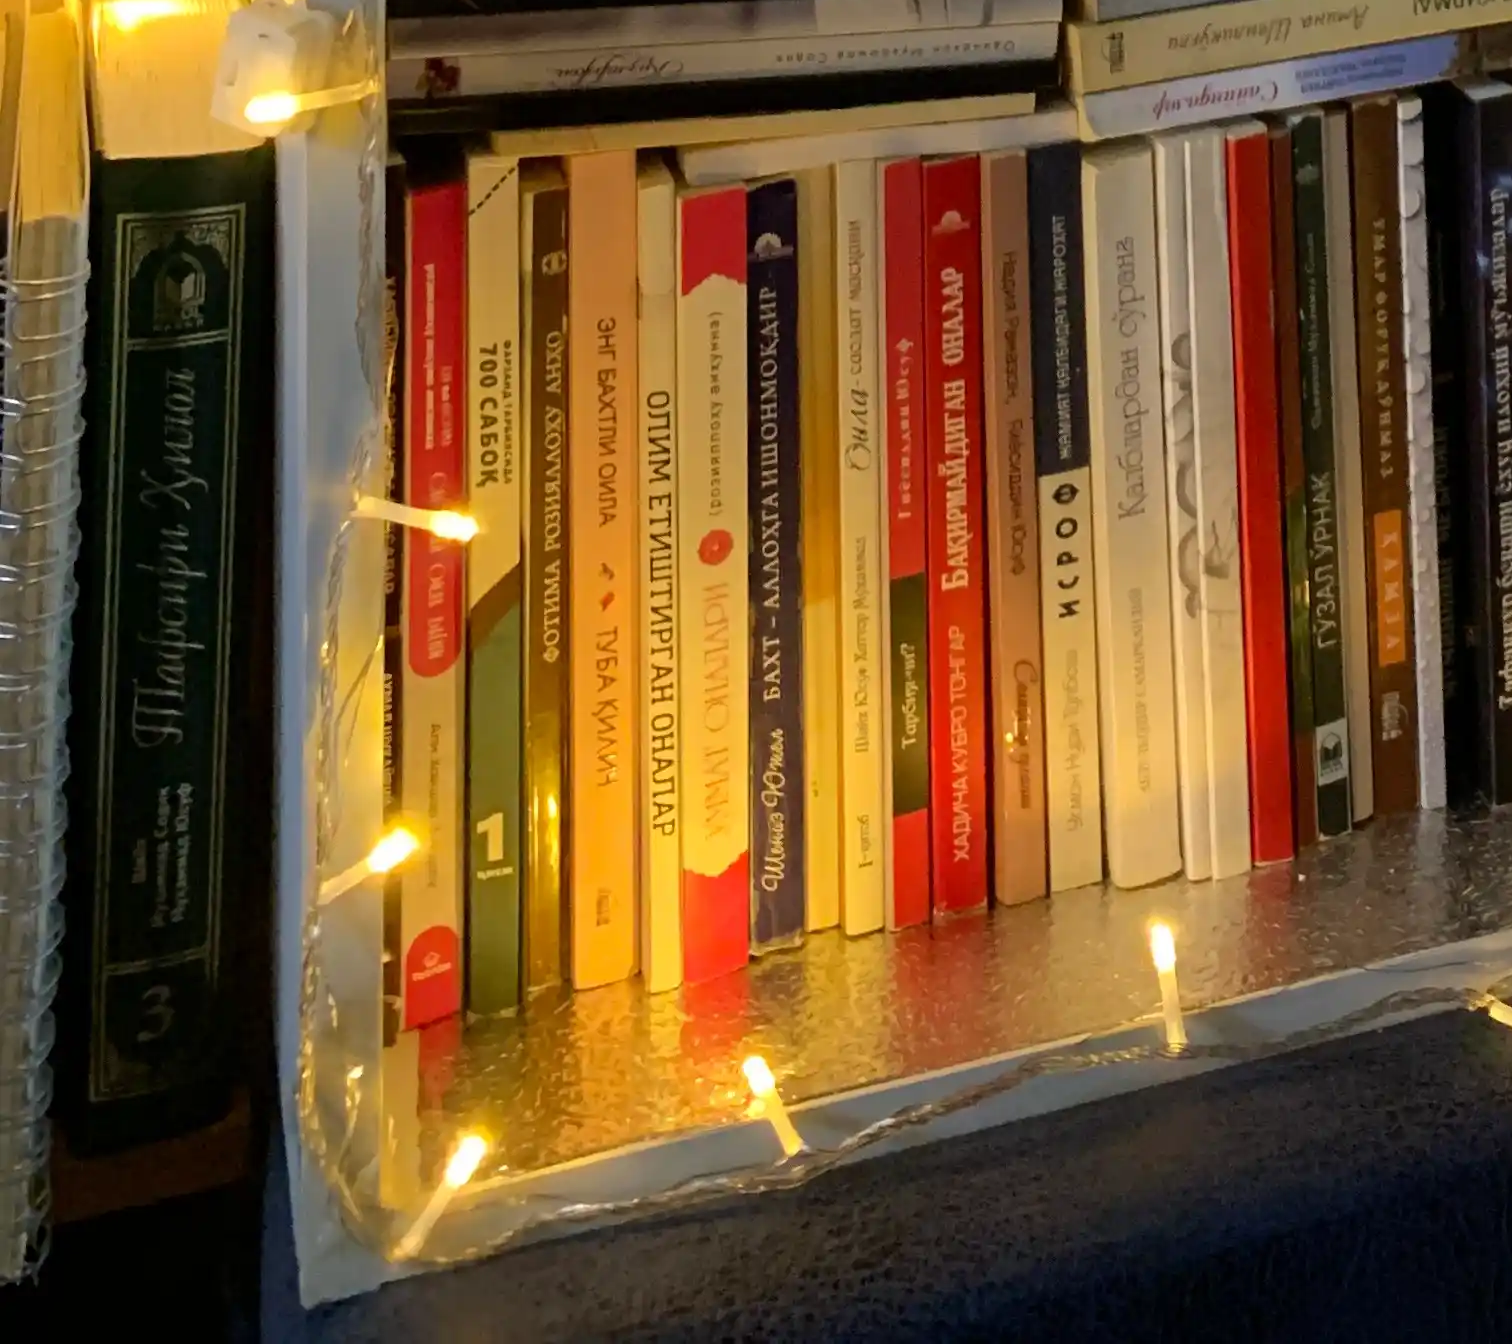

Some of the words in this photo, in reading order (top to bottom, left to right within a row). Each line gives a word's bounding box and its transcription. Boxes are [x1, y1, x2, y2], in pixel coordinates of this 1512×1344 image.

[1114, 236, 1147, 337] сўранг
[479, 343, 499, 388] 700
[598, 316, 618, 361] ЭНГ
[475, 397, 500, 488] САБОҚ
[598, 368, 618, 457] БАХТЛИ
[645, 391, 672, 484] ОЛИМ
[1115, 348, 1148, 520] Қалблардан
[598, 463, 619, 529] ОИЛА
[1308, 471, 1335, 557] ЎРНАК
[1052, 482, 1083, 620] ИСРОФ
[647, 494, 674, 704] ЕТИШТИРГАН
[1312, 563, 1338, 650] ГЎЗАЛ
[760, 636, 781, 701] БАХТ
[650, 713, 676, 837] ОНАЛАР
[474, 810, 507, 863] 1
